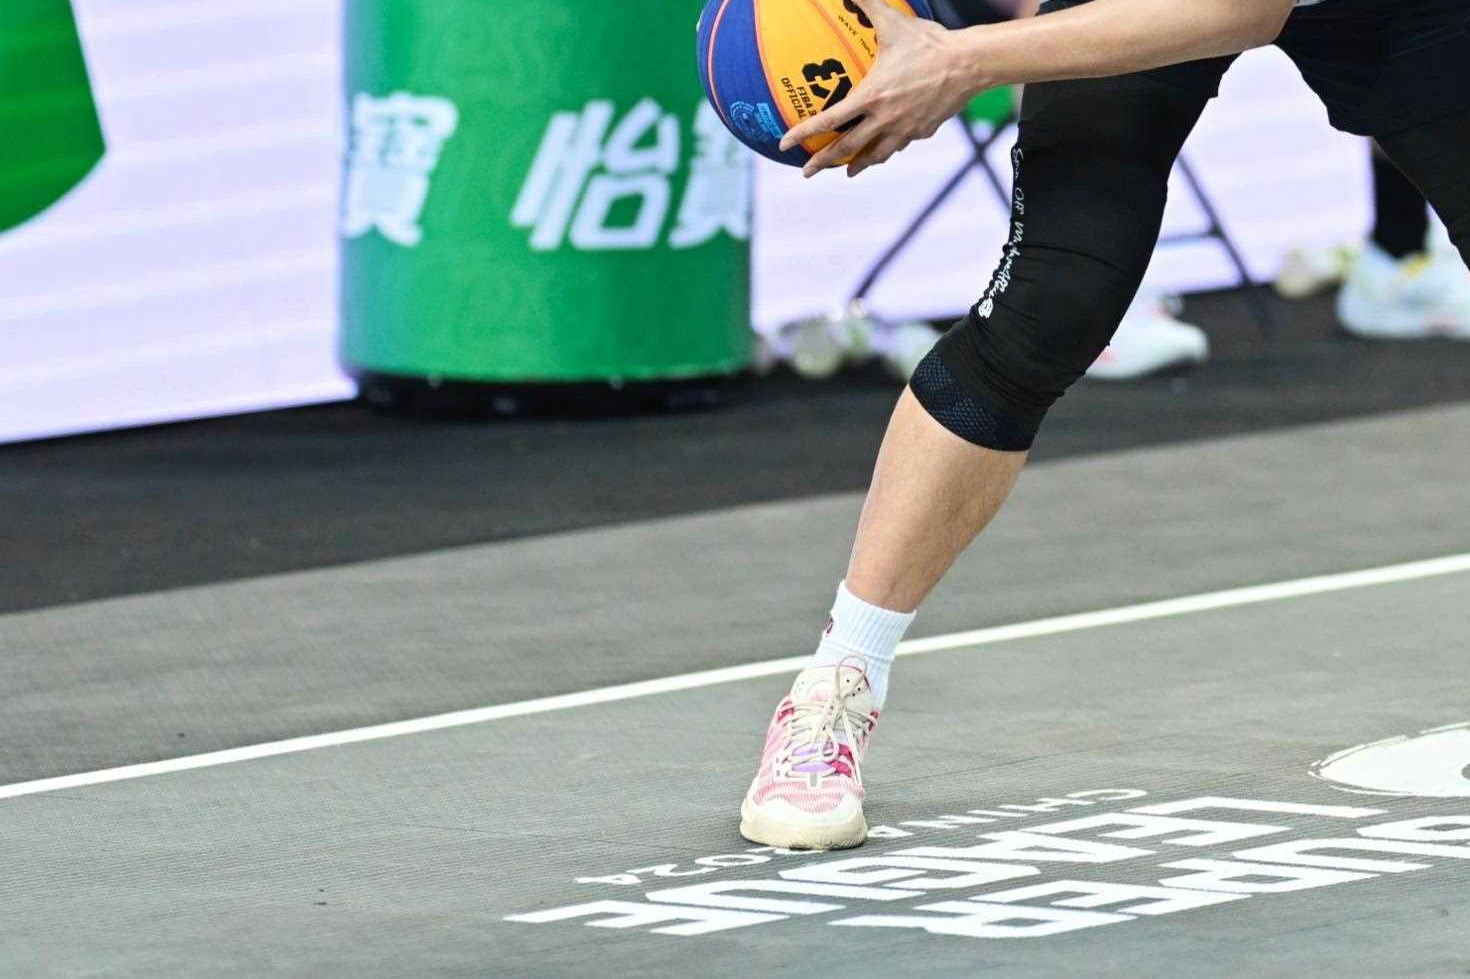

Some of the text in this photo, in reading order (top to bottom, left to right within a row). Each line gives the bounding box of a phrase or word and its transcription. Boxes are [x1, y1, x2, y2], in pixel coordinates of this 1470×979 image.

[797, 86, 813, 109] FIBA
[867, 788, 1149, 839] CHINA
[500, 795, 1390, 937] LEAGUE
